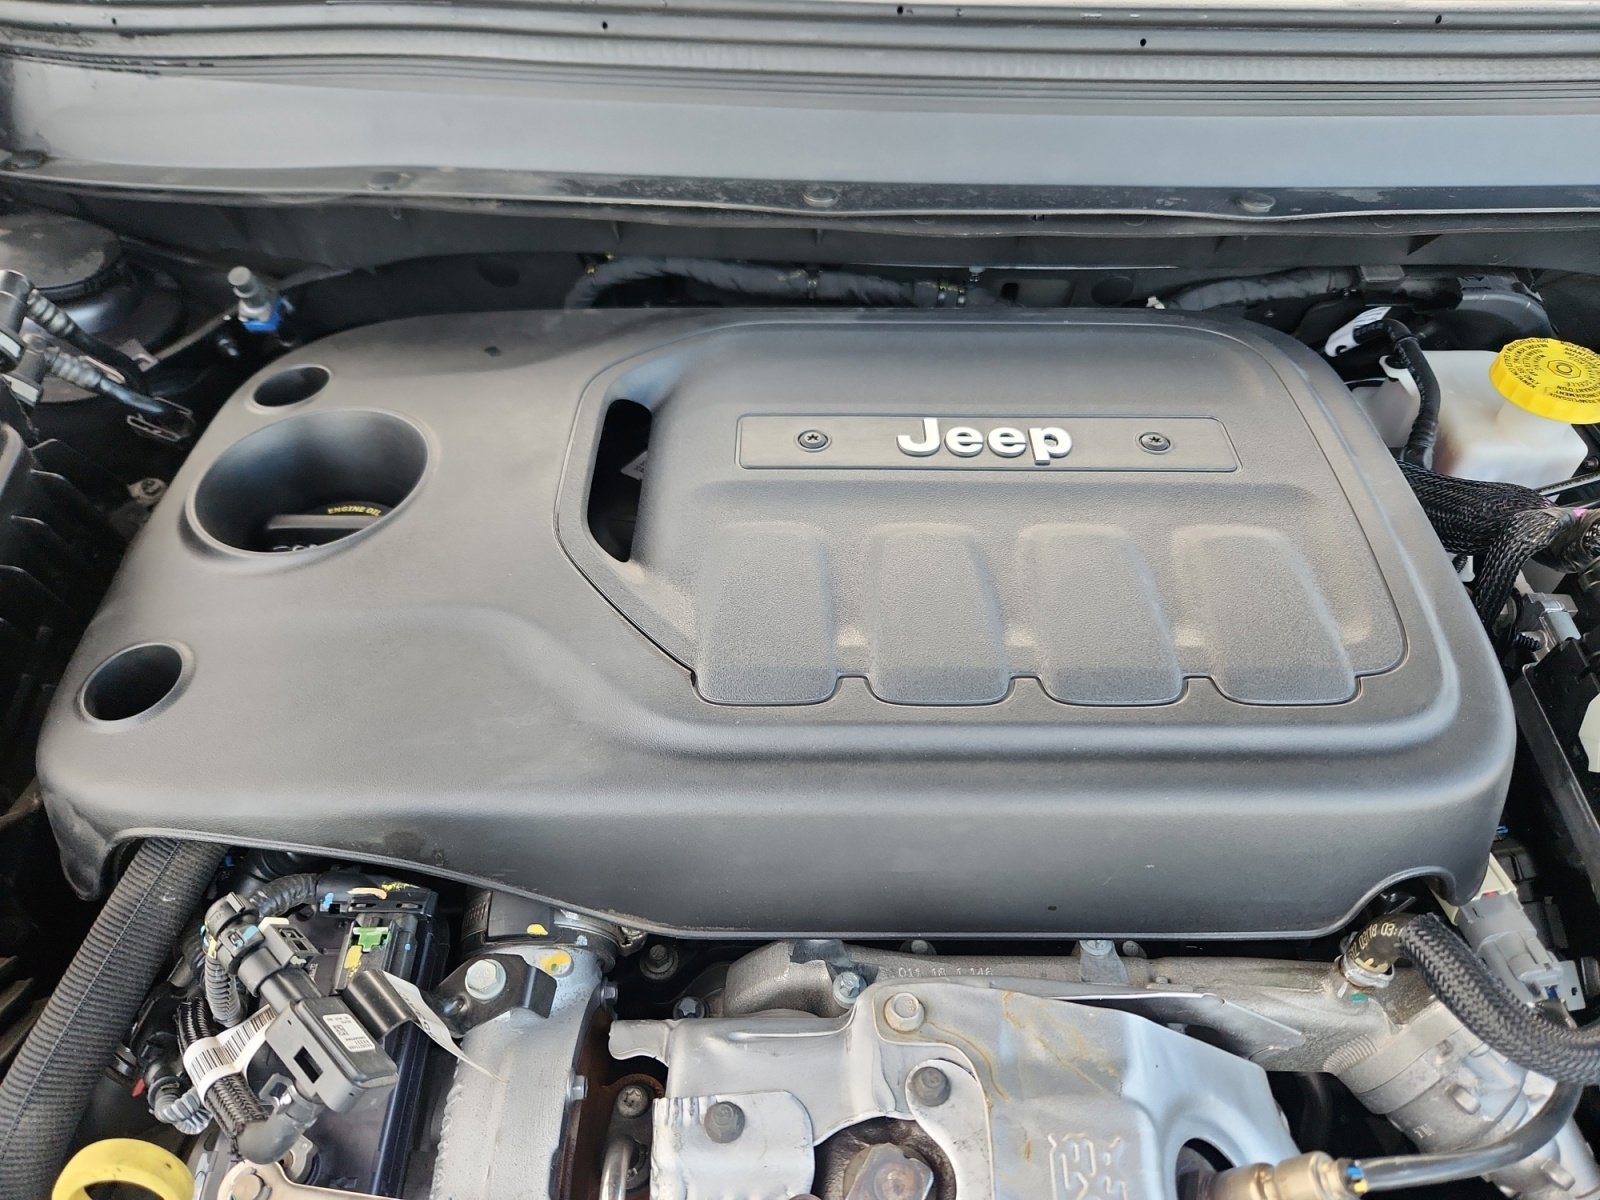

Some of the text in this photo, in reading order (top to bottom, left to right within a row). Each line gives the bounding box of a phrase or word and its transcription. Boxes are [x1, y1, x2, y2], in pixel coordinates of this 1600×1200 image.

[896, 417, 1073, 466] Jeep
[327, 505, 382, 517] ENGINE OIL
